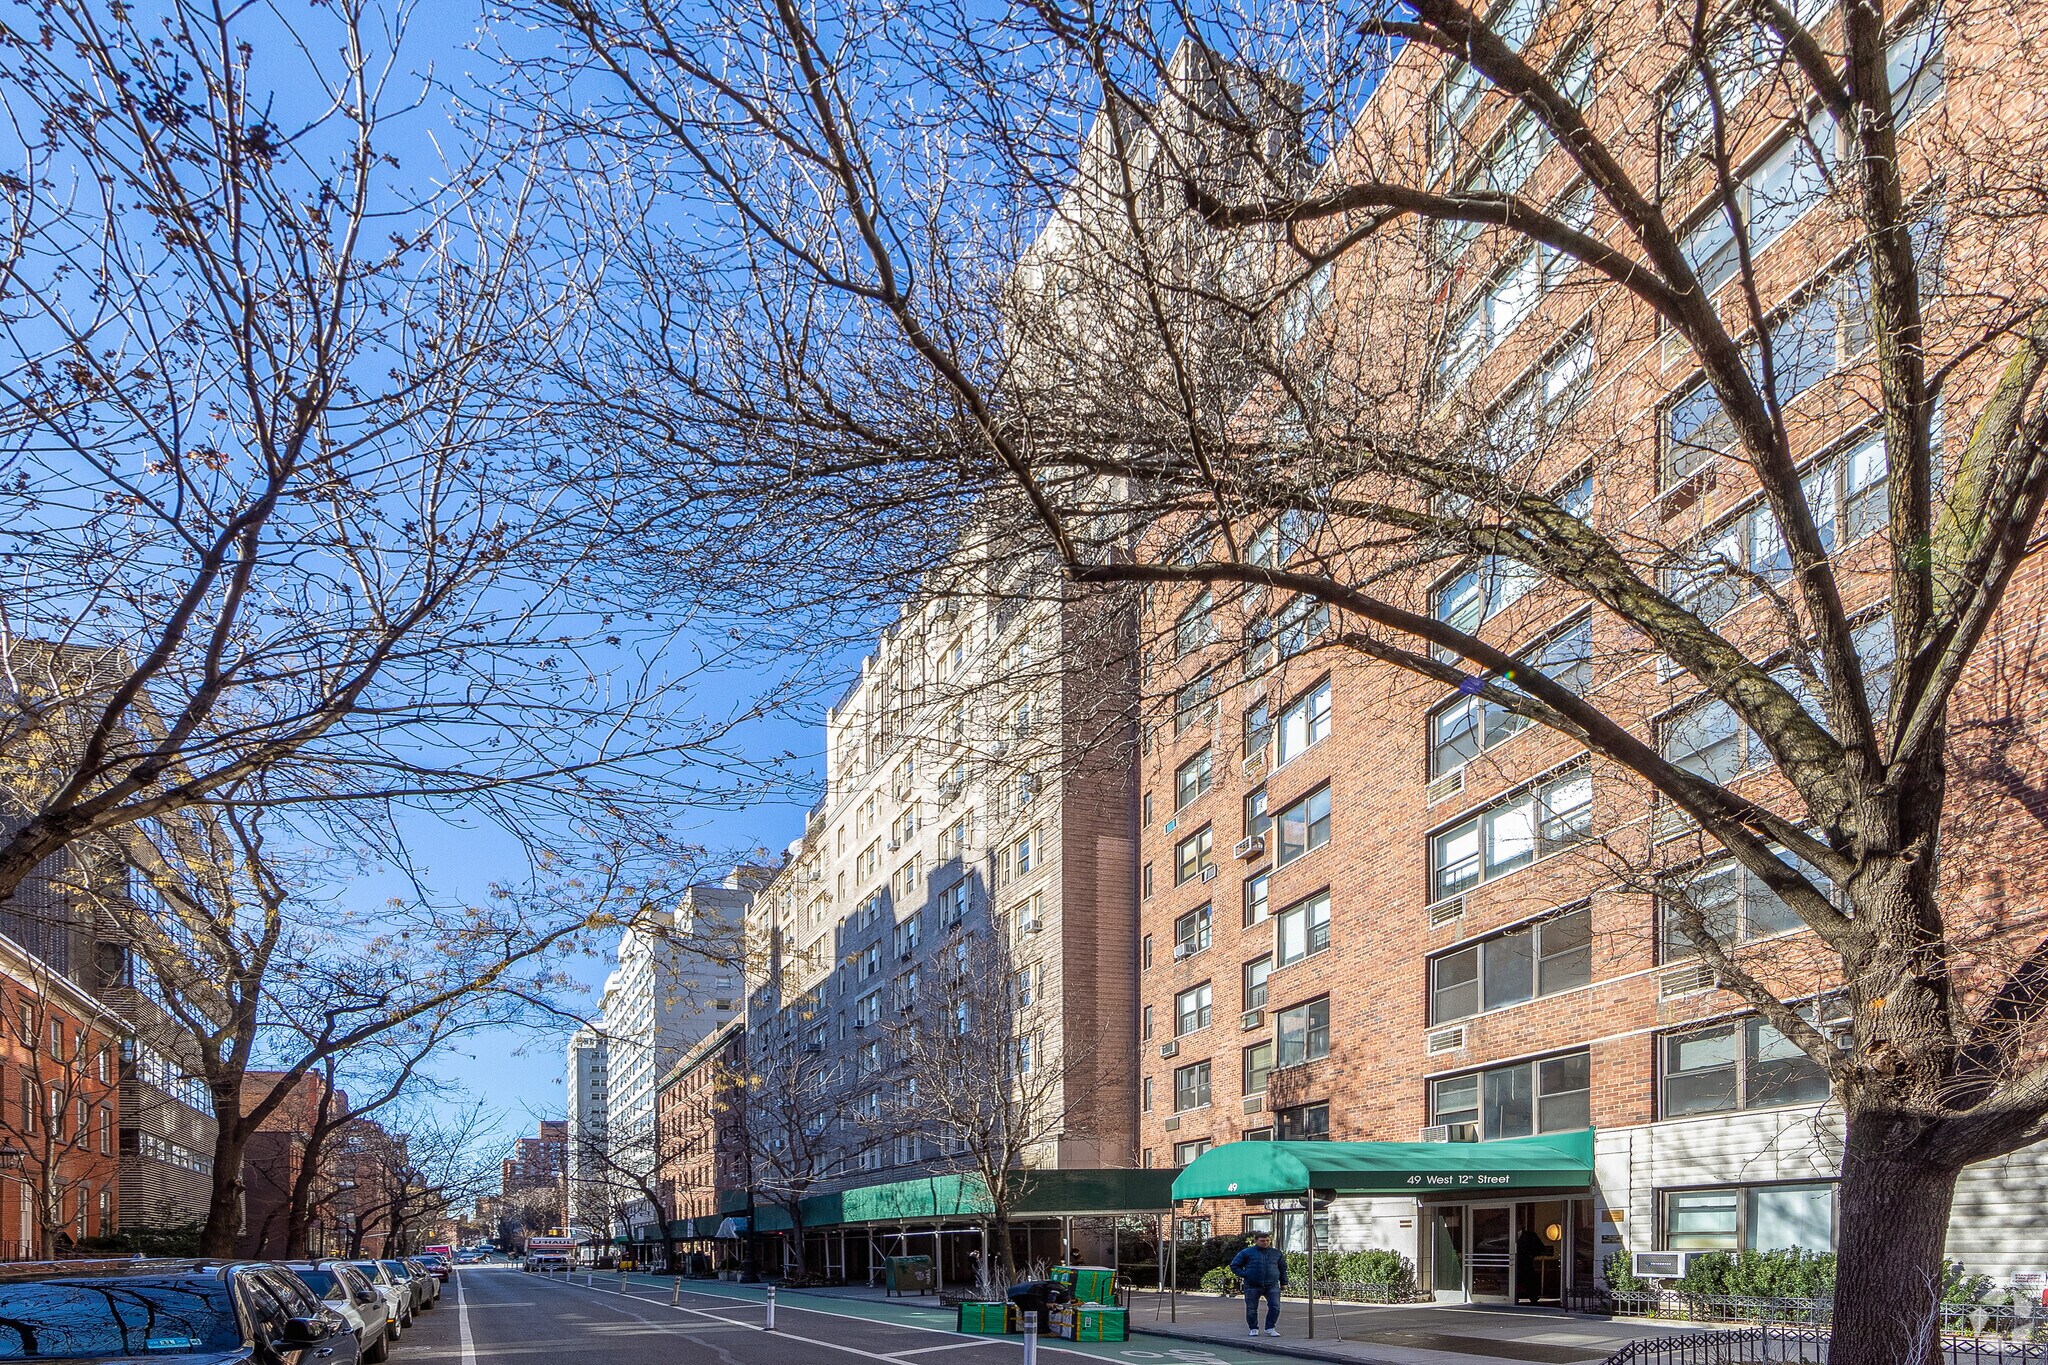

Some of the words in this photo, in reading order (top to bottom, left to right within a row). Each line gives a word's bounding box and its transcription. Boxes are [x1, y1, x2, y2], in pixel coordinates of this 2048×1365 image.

[1406, 1175, 1422, 1184] 49
[1426, 1175, 1453, 1184] West
[1458, 1174, 1474, 1184] 12th
[1477, 1174, 1510, 1184] Street
[1228, 1182, 1238, 1192] 49
